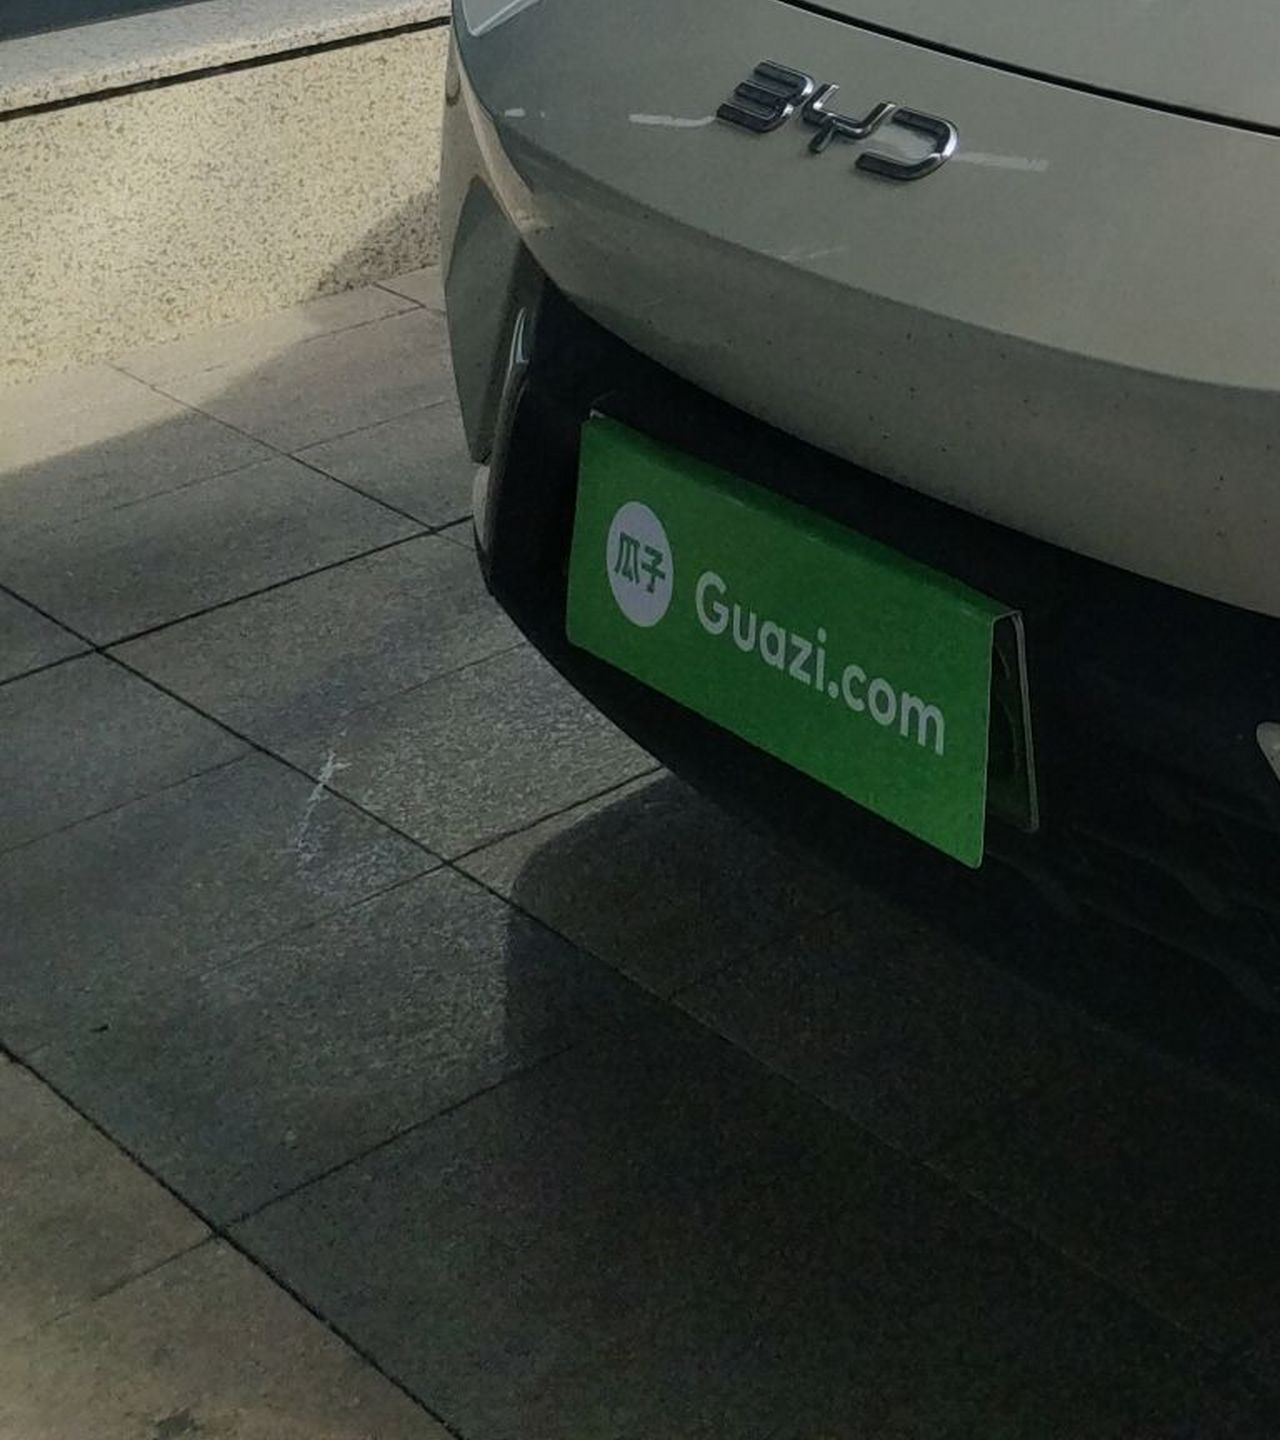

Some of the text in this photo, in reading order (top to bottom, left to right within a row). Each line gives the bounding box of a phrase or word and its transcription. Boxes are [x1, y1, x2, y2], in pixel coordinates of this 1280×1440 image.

[716, 59, 959, 181] BYD
[614, 531, 666, 594] 瓜子
[695, 570, 946, 757] Guazi.com
